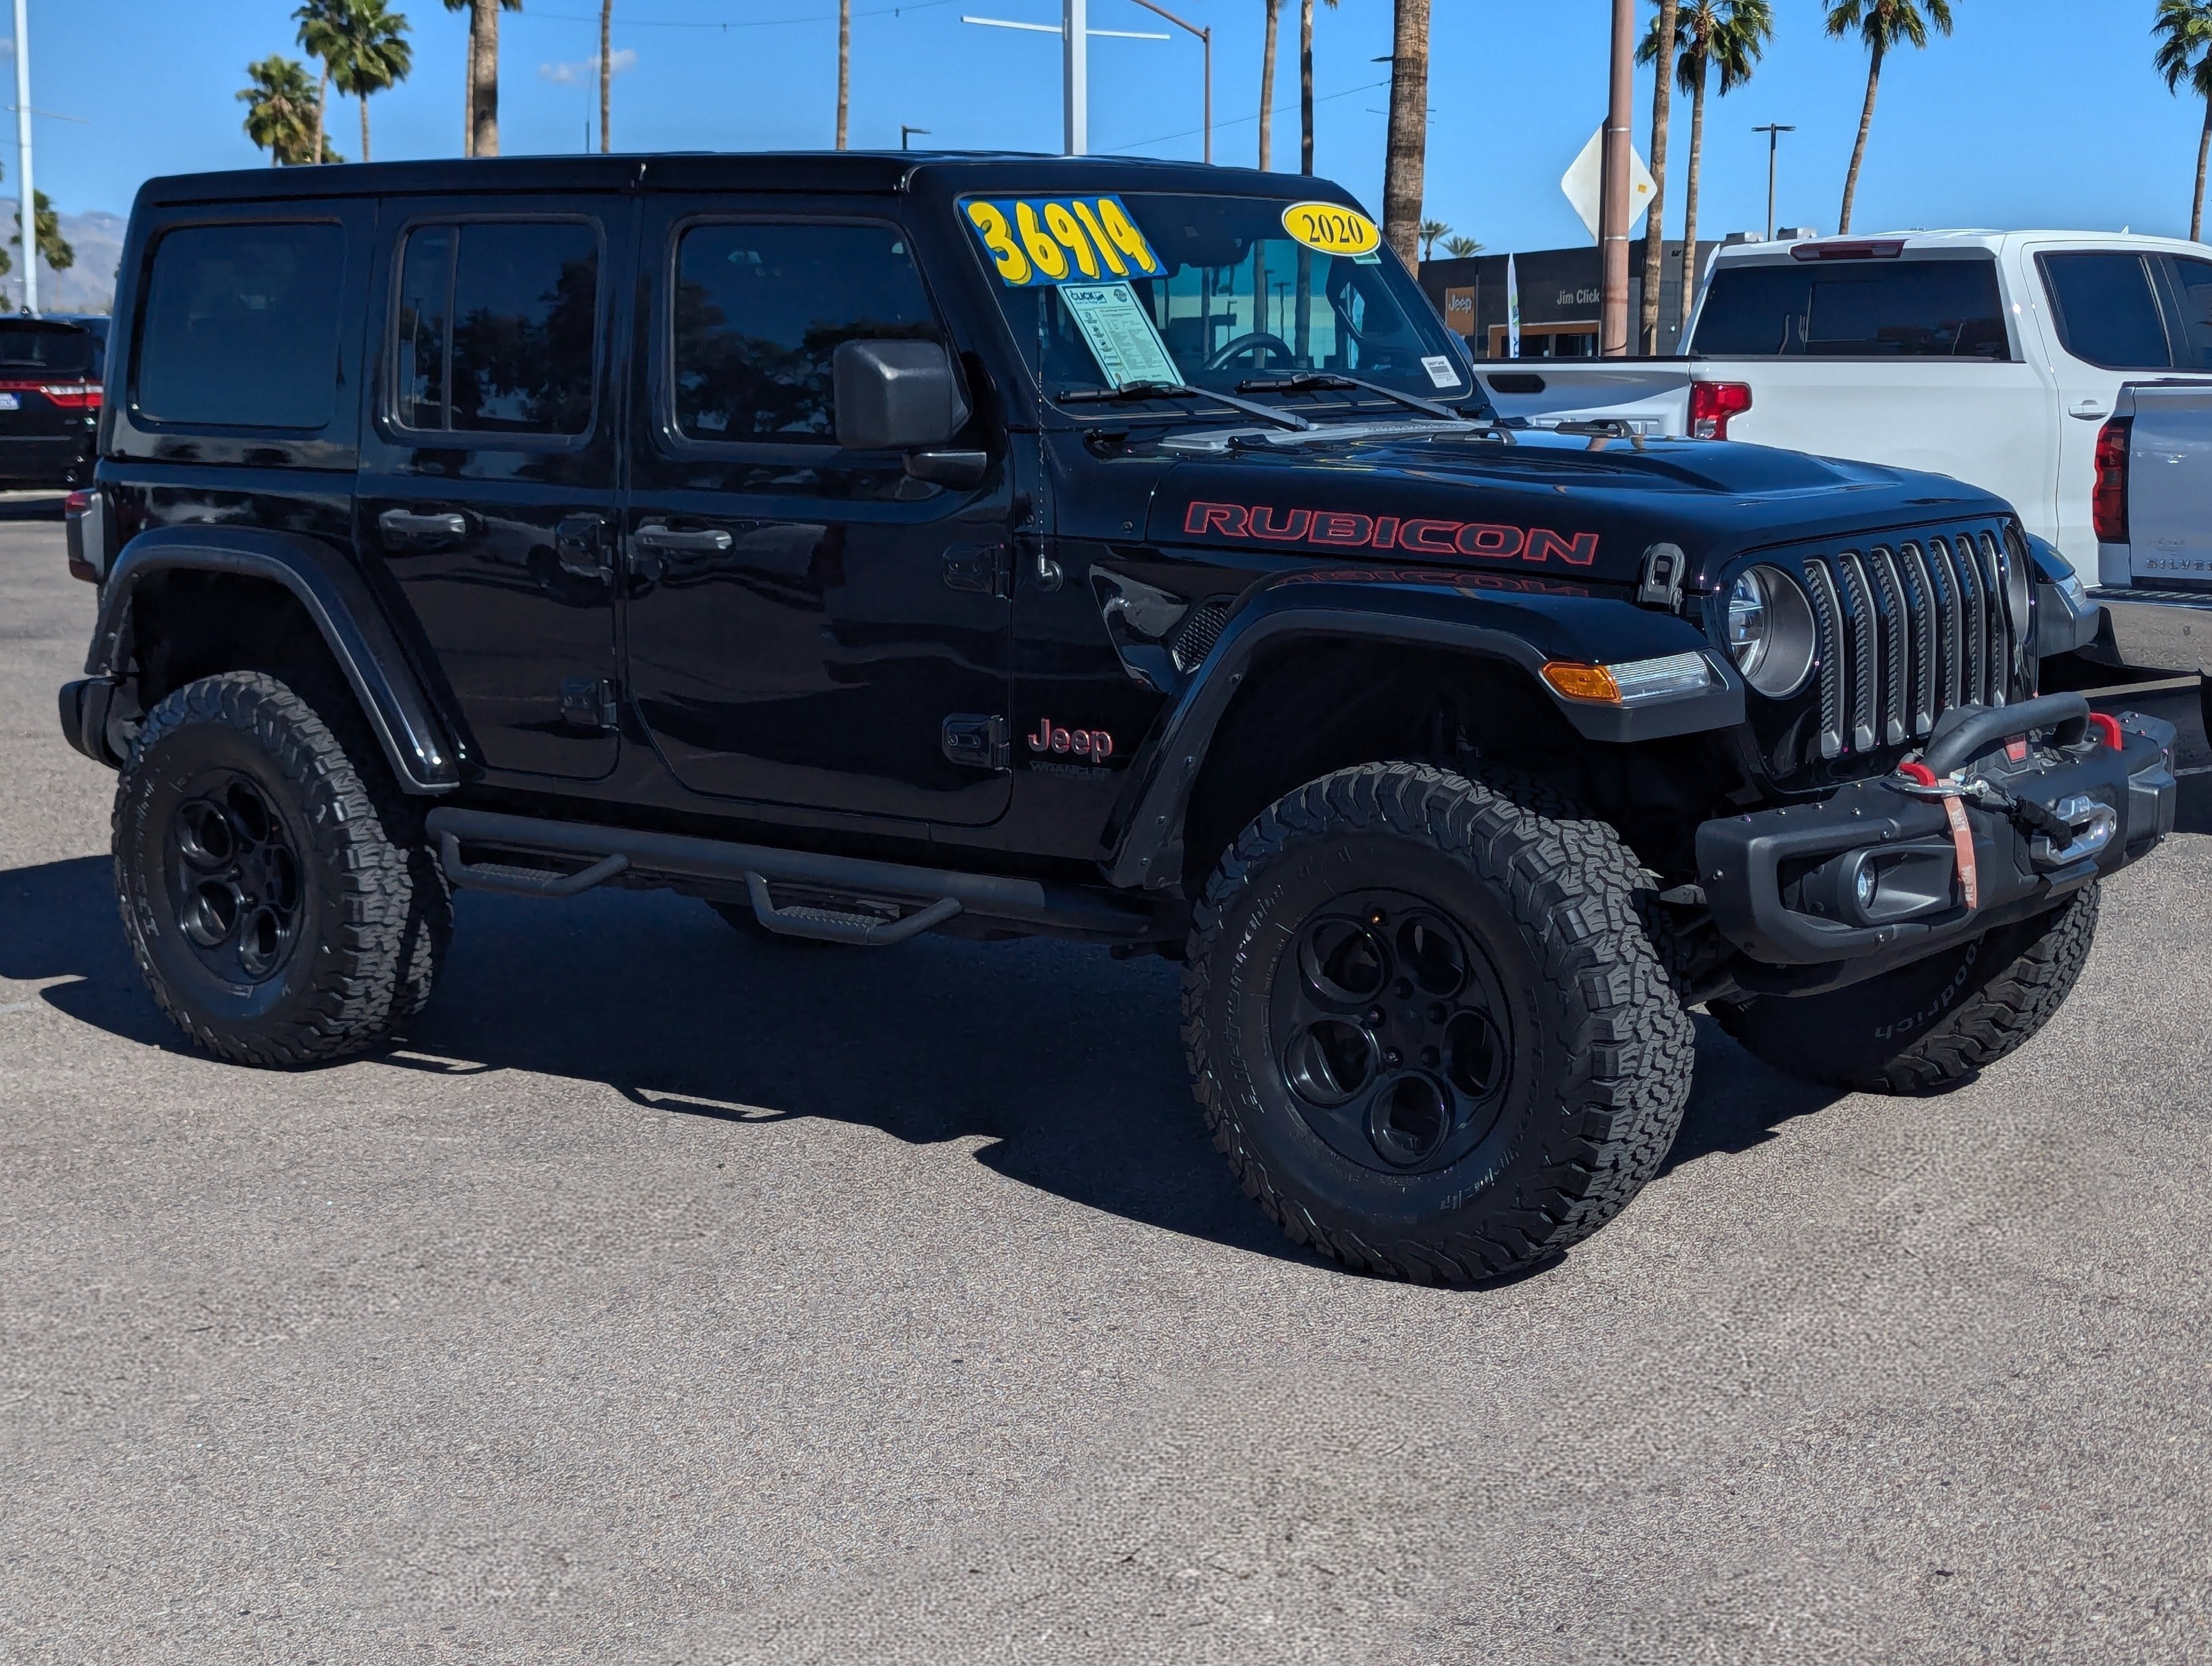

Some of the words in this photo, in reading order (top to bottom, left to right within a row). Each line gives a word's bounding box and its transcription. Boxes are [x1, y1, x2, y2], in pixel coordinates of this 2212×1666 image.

[967, 199, 1157, 285] 36914
[1302, 214, 1364, 244] 2020
[1448, 294, 1472, 314] Jeep
[1557, 289, 1574, 305] Jim
[1576, 288, 1600, 304] Click
[1184, 501, 1599, 566] RUBICON
[1028, 717, 1113, 763] Jeep
[1874, 930, 1985, 1040] oodrich
